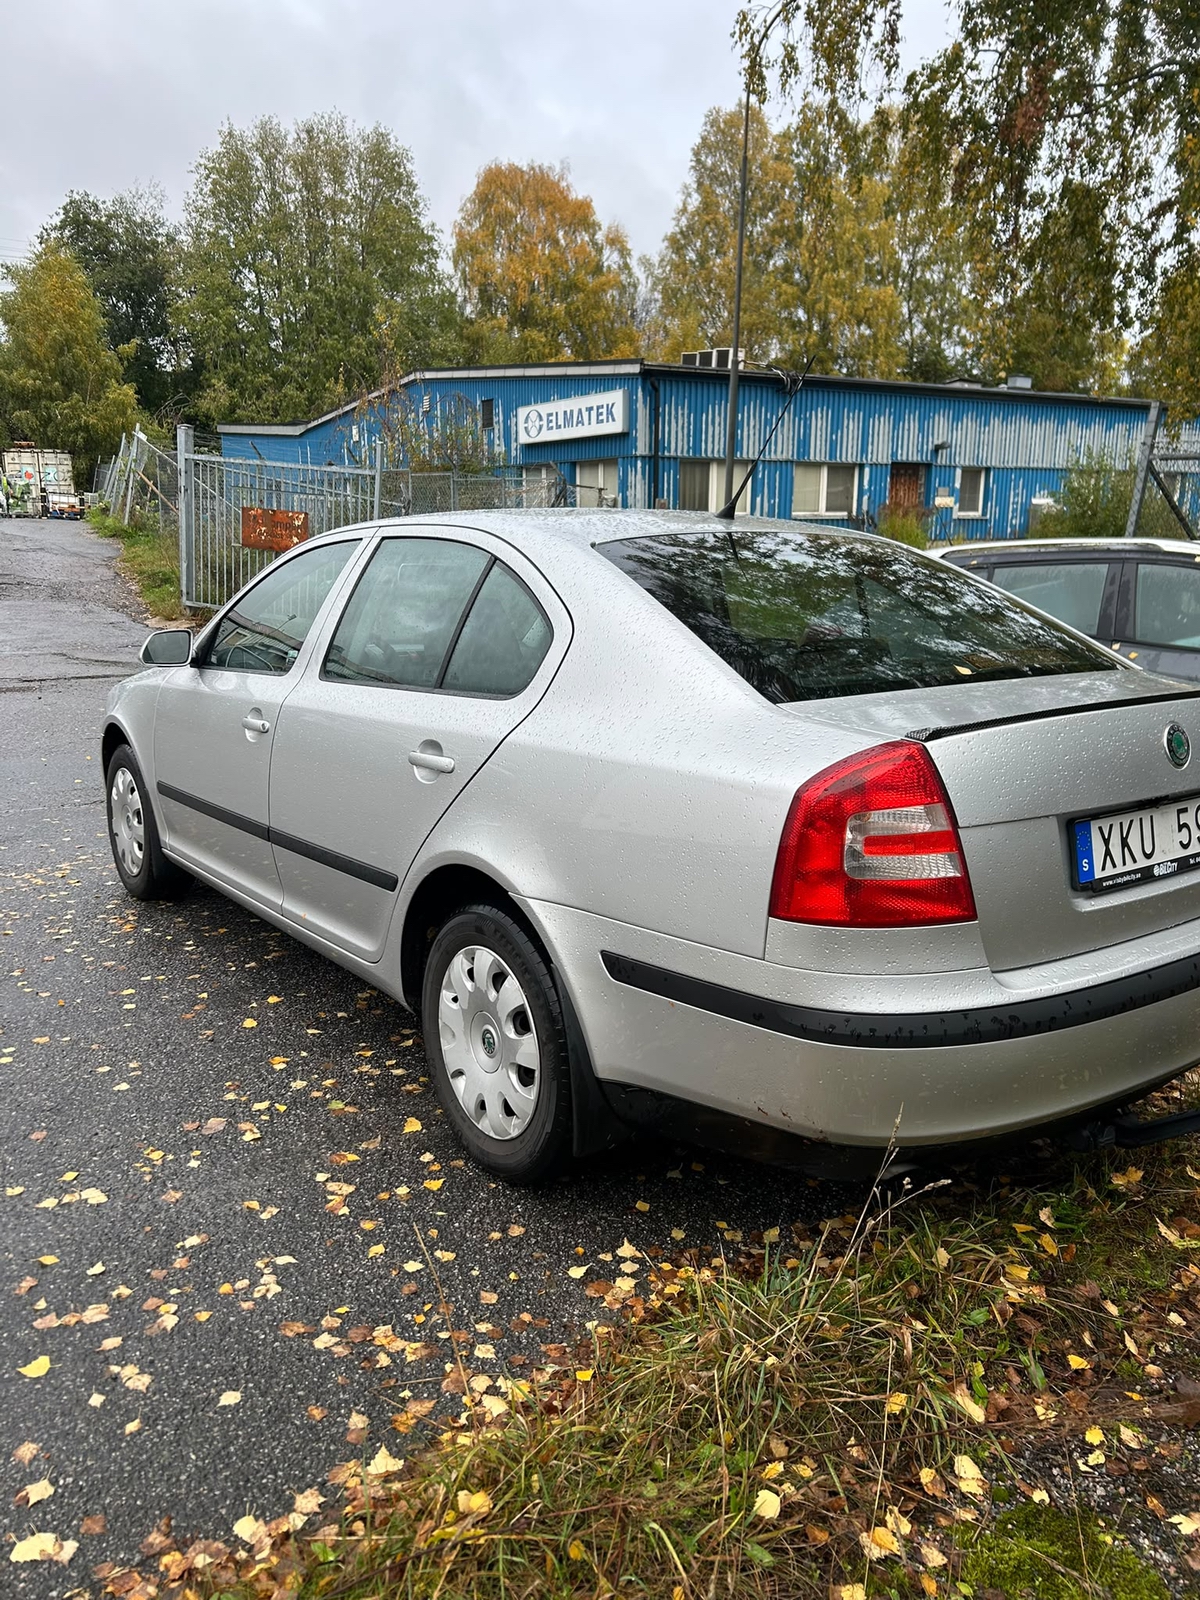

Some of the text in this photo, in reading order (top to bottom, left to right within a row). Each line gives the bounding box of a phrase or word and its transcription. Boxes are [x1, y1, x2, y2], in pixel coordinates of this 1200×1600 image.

[546, 401, 617, 431] ELMATEK
[1097, 814, 1156, 872] XKU
[1082, 858, 1089, 871] S
